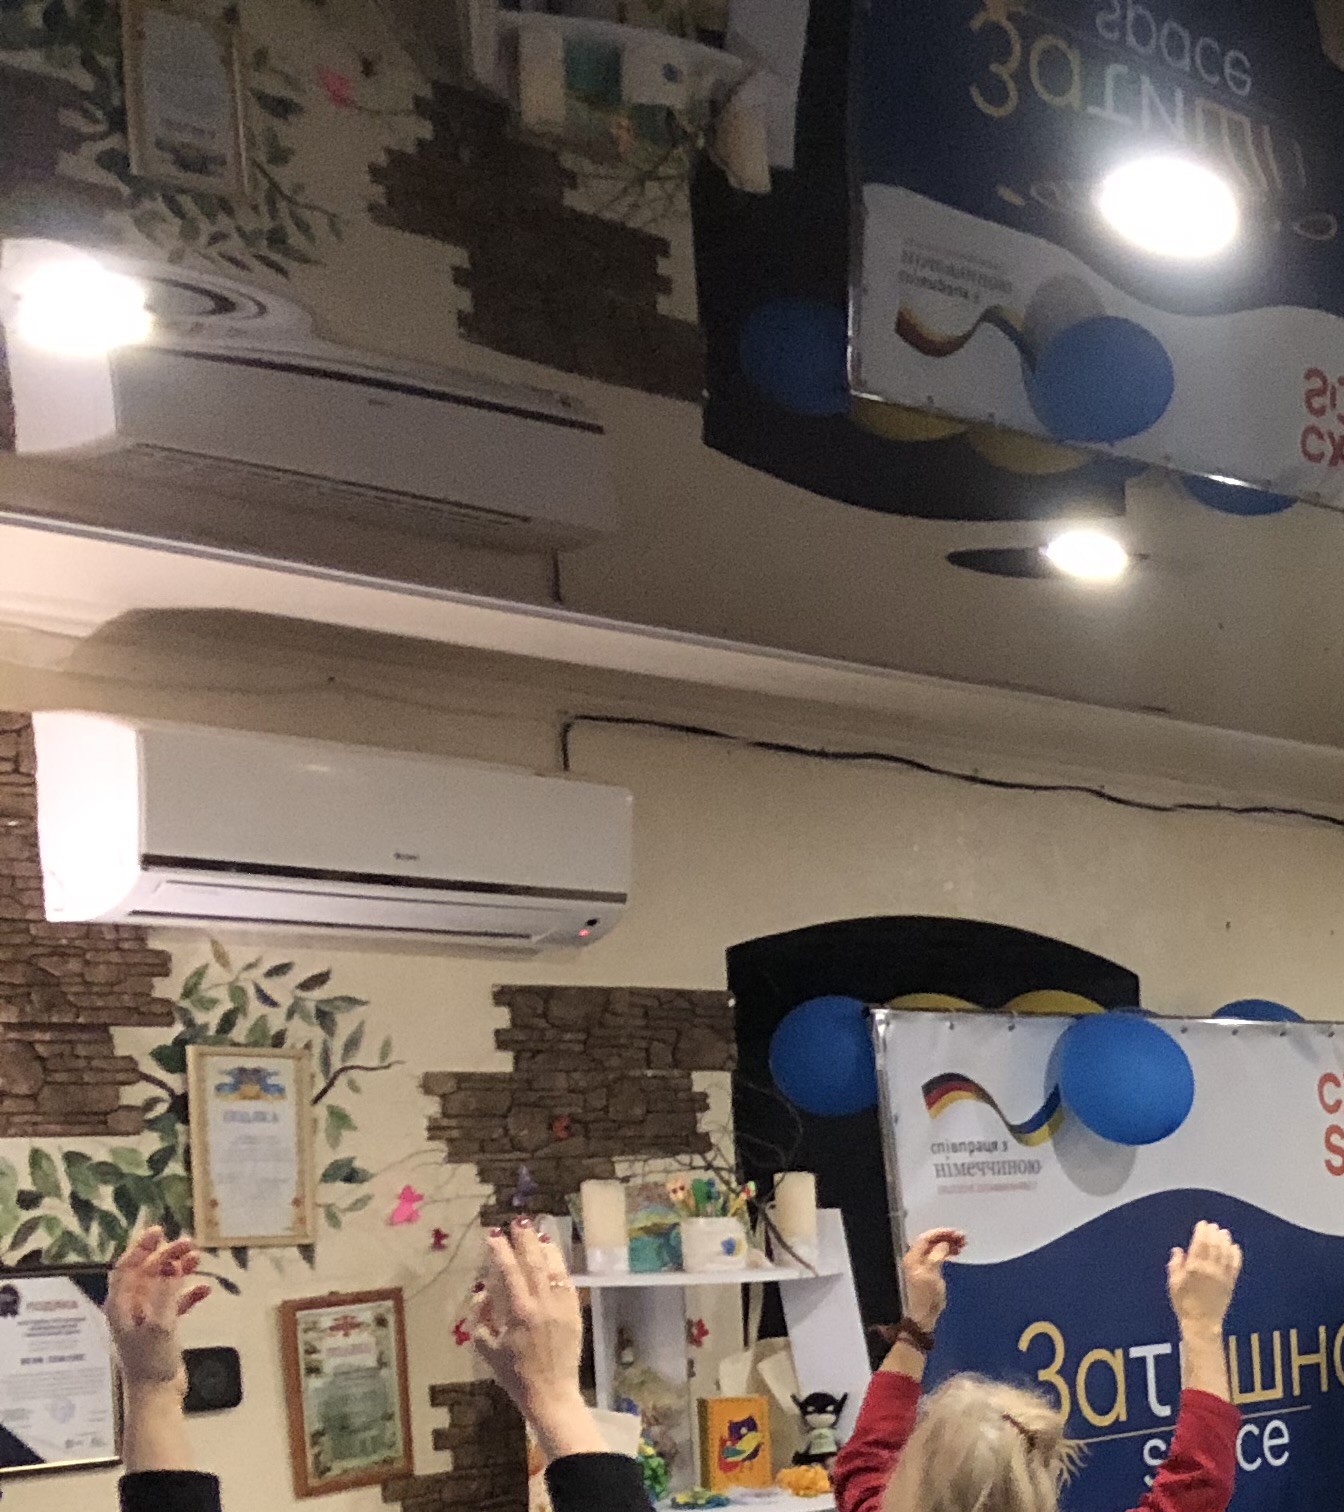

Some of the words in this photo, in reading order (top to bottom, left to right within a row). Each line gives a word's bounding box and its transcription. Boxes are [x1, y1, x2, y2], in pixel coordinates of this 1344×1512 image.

[930, 1139, 998, 1157] співпраця
[1000, 1140, 1009, 1153] з
[1143, 1420, 1290, 1487] sce
